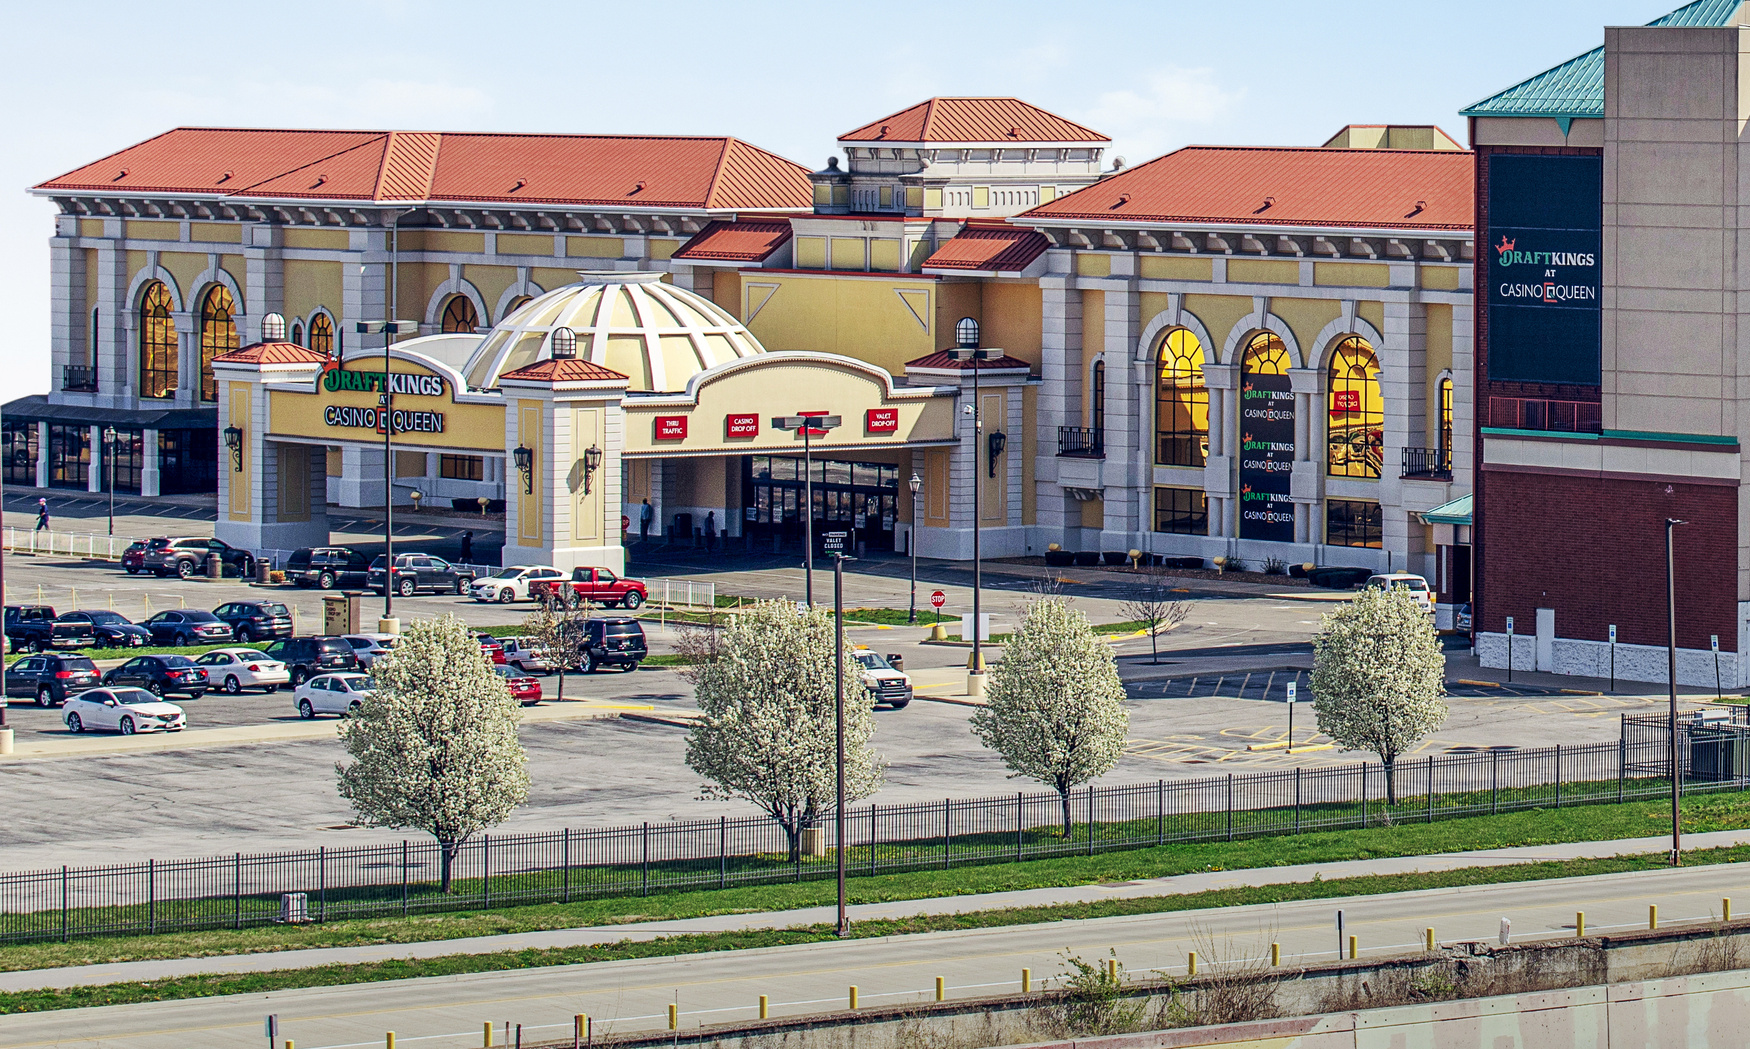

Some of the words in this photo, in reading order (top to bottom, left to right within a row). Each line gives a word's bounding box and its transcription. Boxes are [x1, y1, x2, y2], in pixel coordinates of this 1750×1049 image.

[1499, 249, 1595, 267] DRAFTKINGS
[1544, 269, 1557, 277] AT
[1500, 283, 1543, 298] CASINO
[1556, 284, 1595, 301] QUEEN
[325, 406, 375, 428] CASINO
[393, 409, 442, 432] QUEEN
[1244, 408, 1267, 418] CASINO
[1274, 410, 1295, 420] QUEEN
[1243, 459, 1266, 469] CASINO
[1244, 510, 1267, 520] CASINO
[931, 595, 945, 603] STOP
